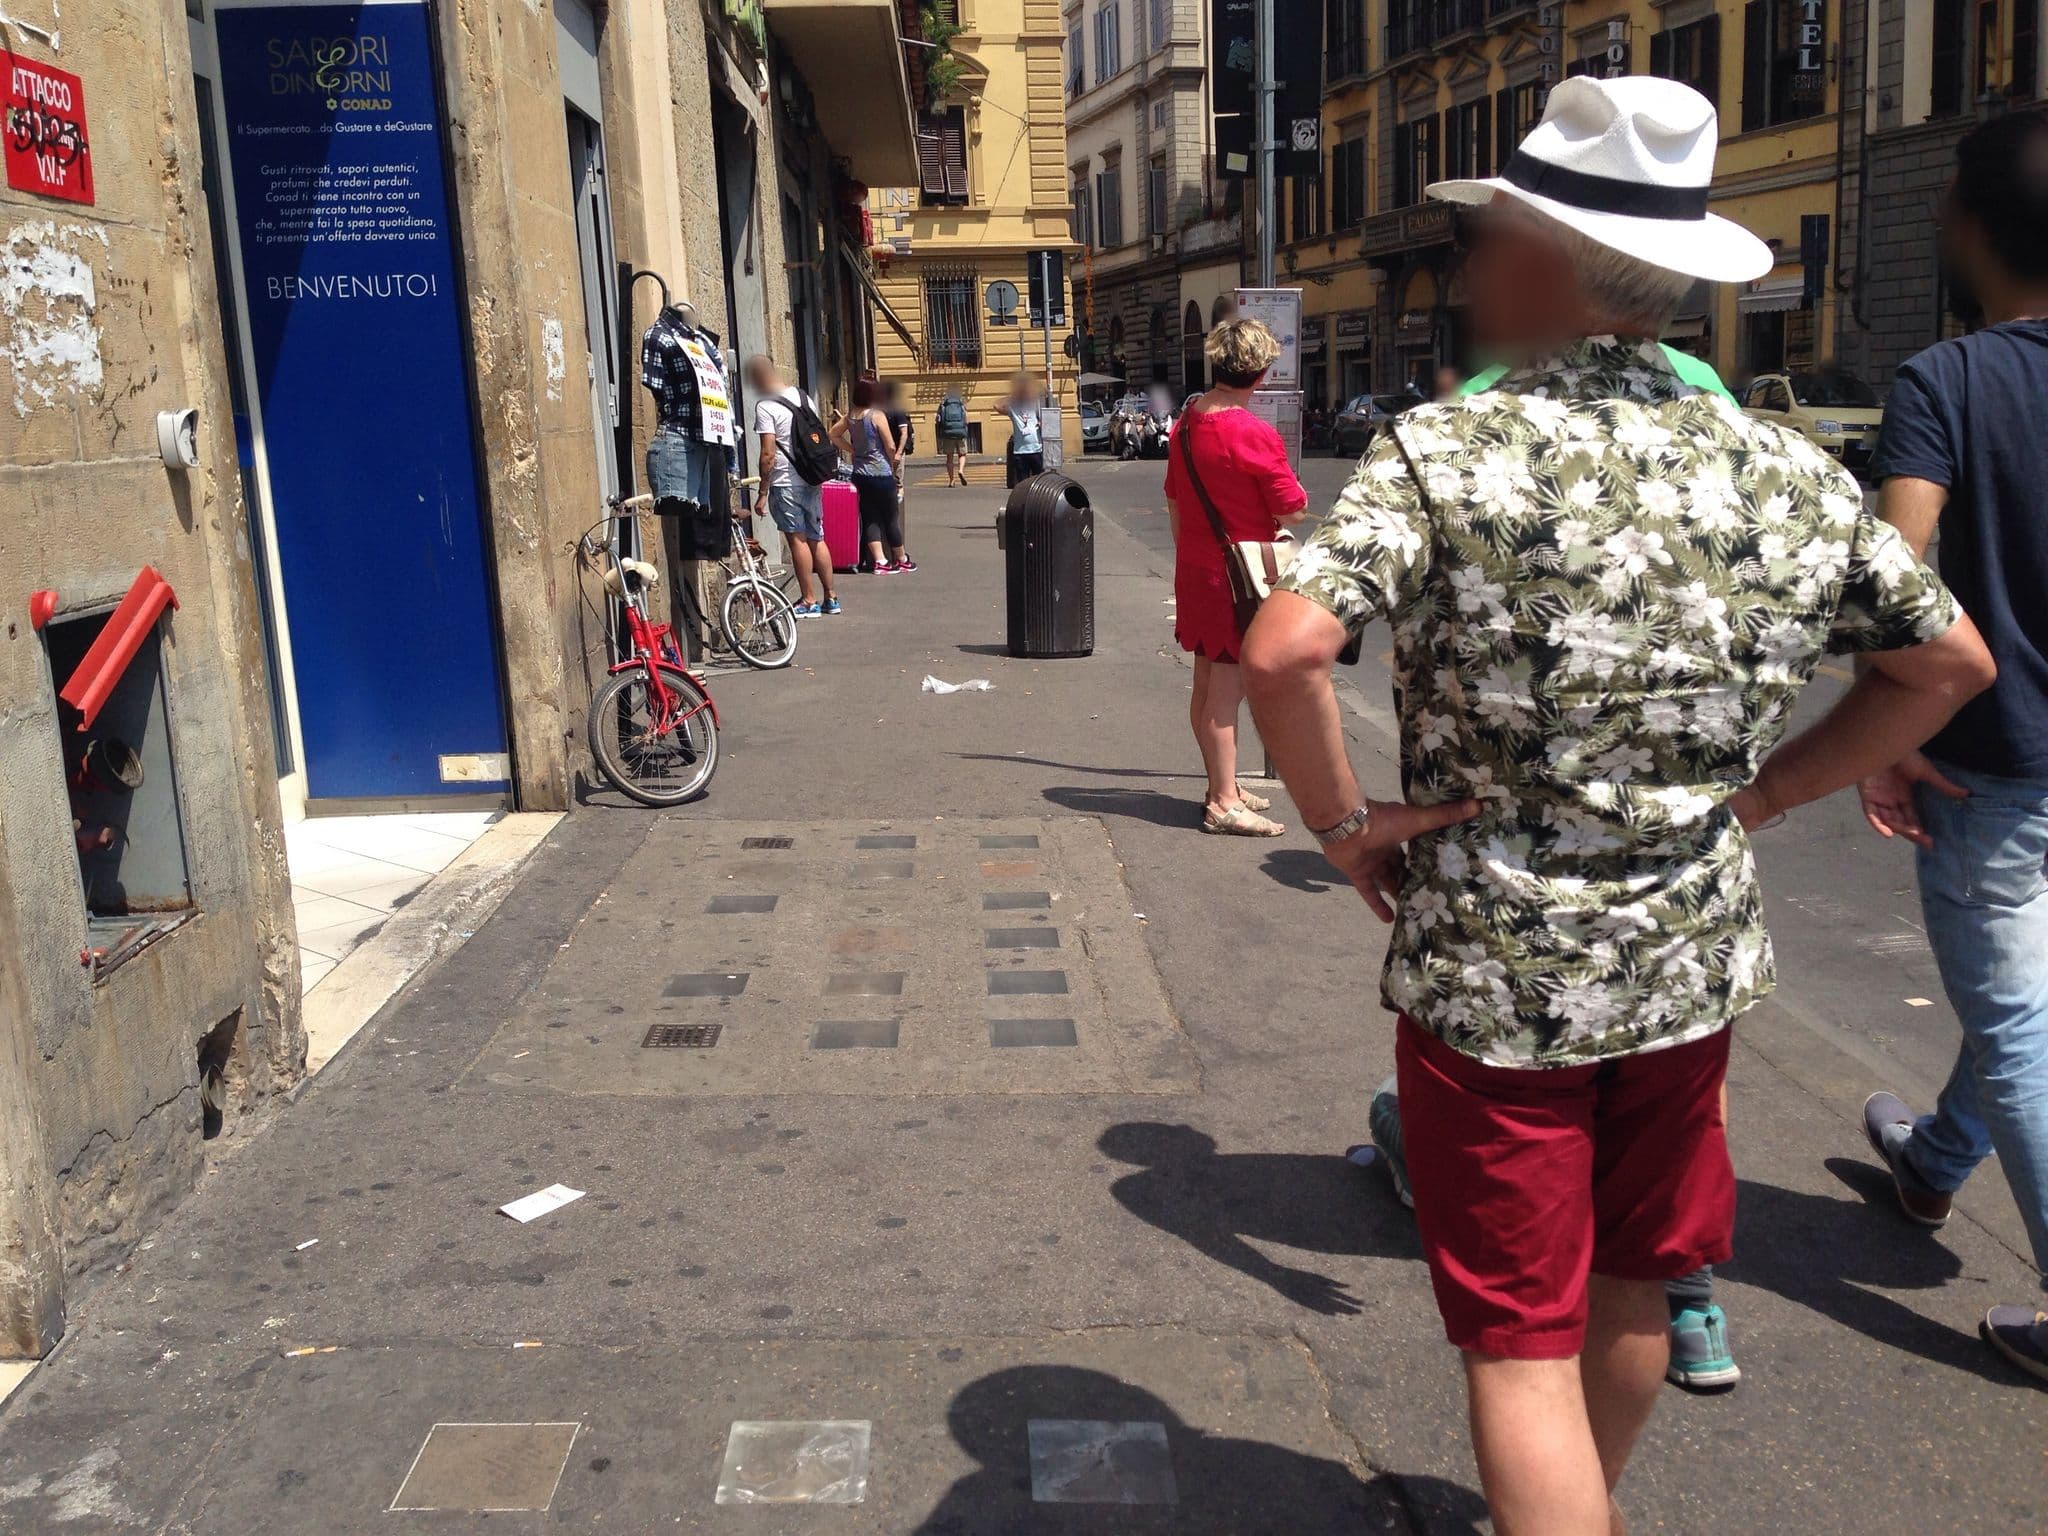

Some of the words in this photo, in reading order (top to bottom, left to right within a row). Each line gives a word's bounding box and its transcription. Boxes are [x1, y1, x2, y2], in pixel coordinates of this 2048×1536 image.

[266, 35, 389, 69] SAPORI
[12, 66, 72, 113] ATTACCO
[270, 70, 391, 96] DINORNI
[340, 98, 393, 111] CONAD
[237, 122, 244, 134] Il
[320, 122, 333, 133] da
[335, 121, 373, 133] Gustare
[375, 124, 382, 132] e
[384, 120, 433, 132] deGustare
[260, 164, 287, 175] Gusti
[290, 163, 334, 176] ritrovati,
[337, 163, 369, 176] sapori
[372, 162, 419, 174] autentici,
[270, 176, 310, 191] profumi
[312, 177, 331, 188] che
[334, 175, 371, 188] credevi
[373, 174, 413, 189] perduti.
[265, 191, 299, 202] Conad
[302, 192, 309, 201] ti
[312, 191, 339, 202] viene
[342, 190, 383, 201] incontro
[386, 191, 405, 201] con
[408, 191, 420, 200] un
[280, 205, 347, 218] supermercato
[350, 204, 373, 215] tutto
[376, 205, 410, 215] nuovo,
[255, 217, 277, 231] che,
[280, 220, 314, 229] mentre
[317, 216, 331, 228] fai
[334, 216, 344, 228] la
[347, 218, 376, 231] spesa
[378, 215, 437, 230] quotidiana,
[256, 232, 263, 243] ti
[266, 233, 309, 246] presenta
[312, 229, 362, 242] un'offerta
[364, 228, 405, 241] davvero
[266, 273, 438, 300] BENVENUTO!
